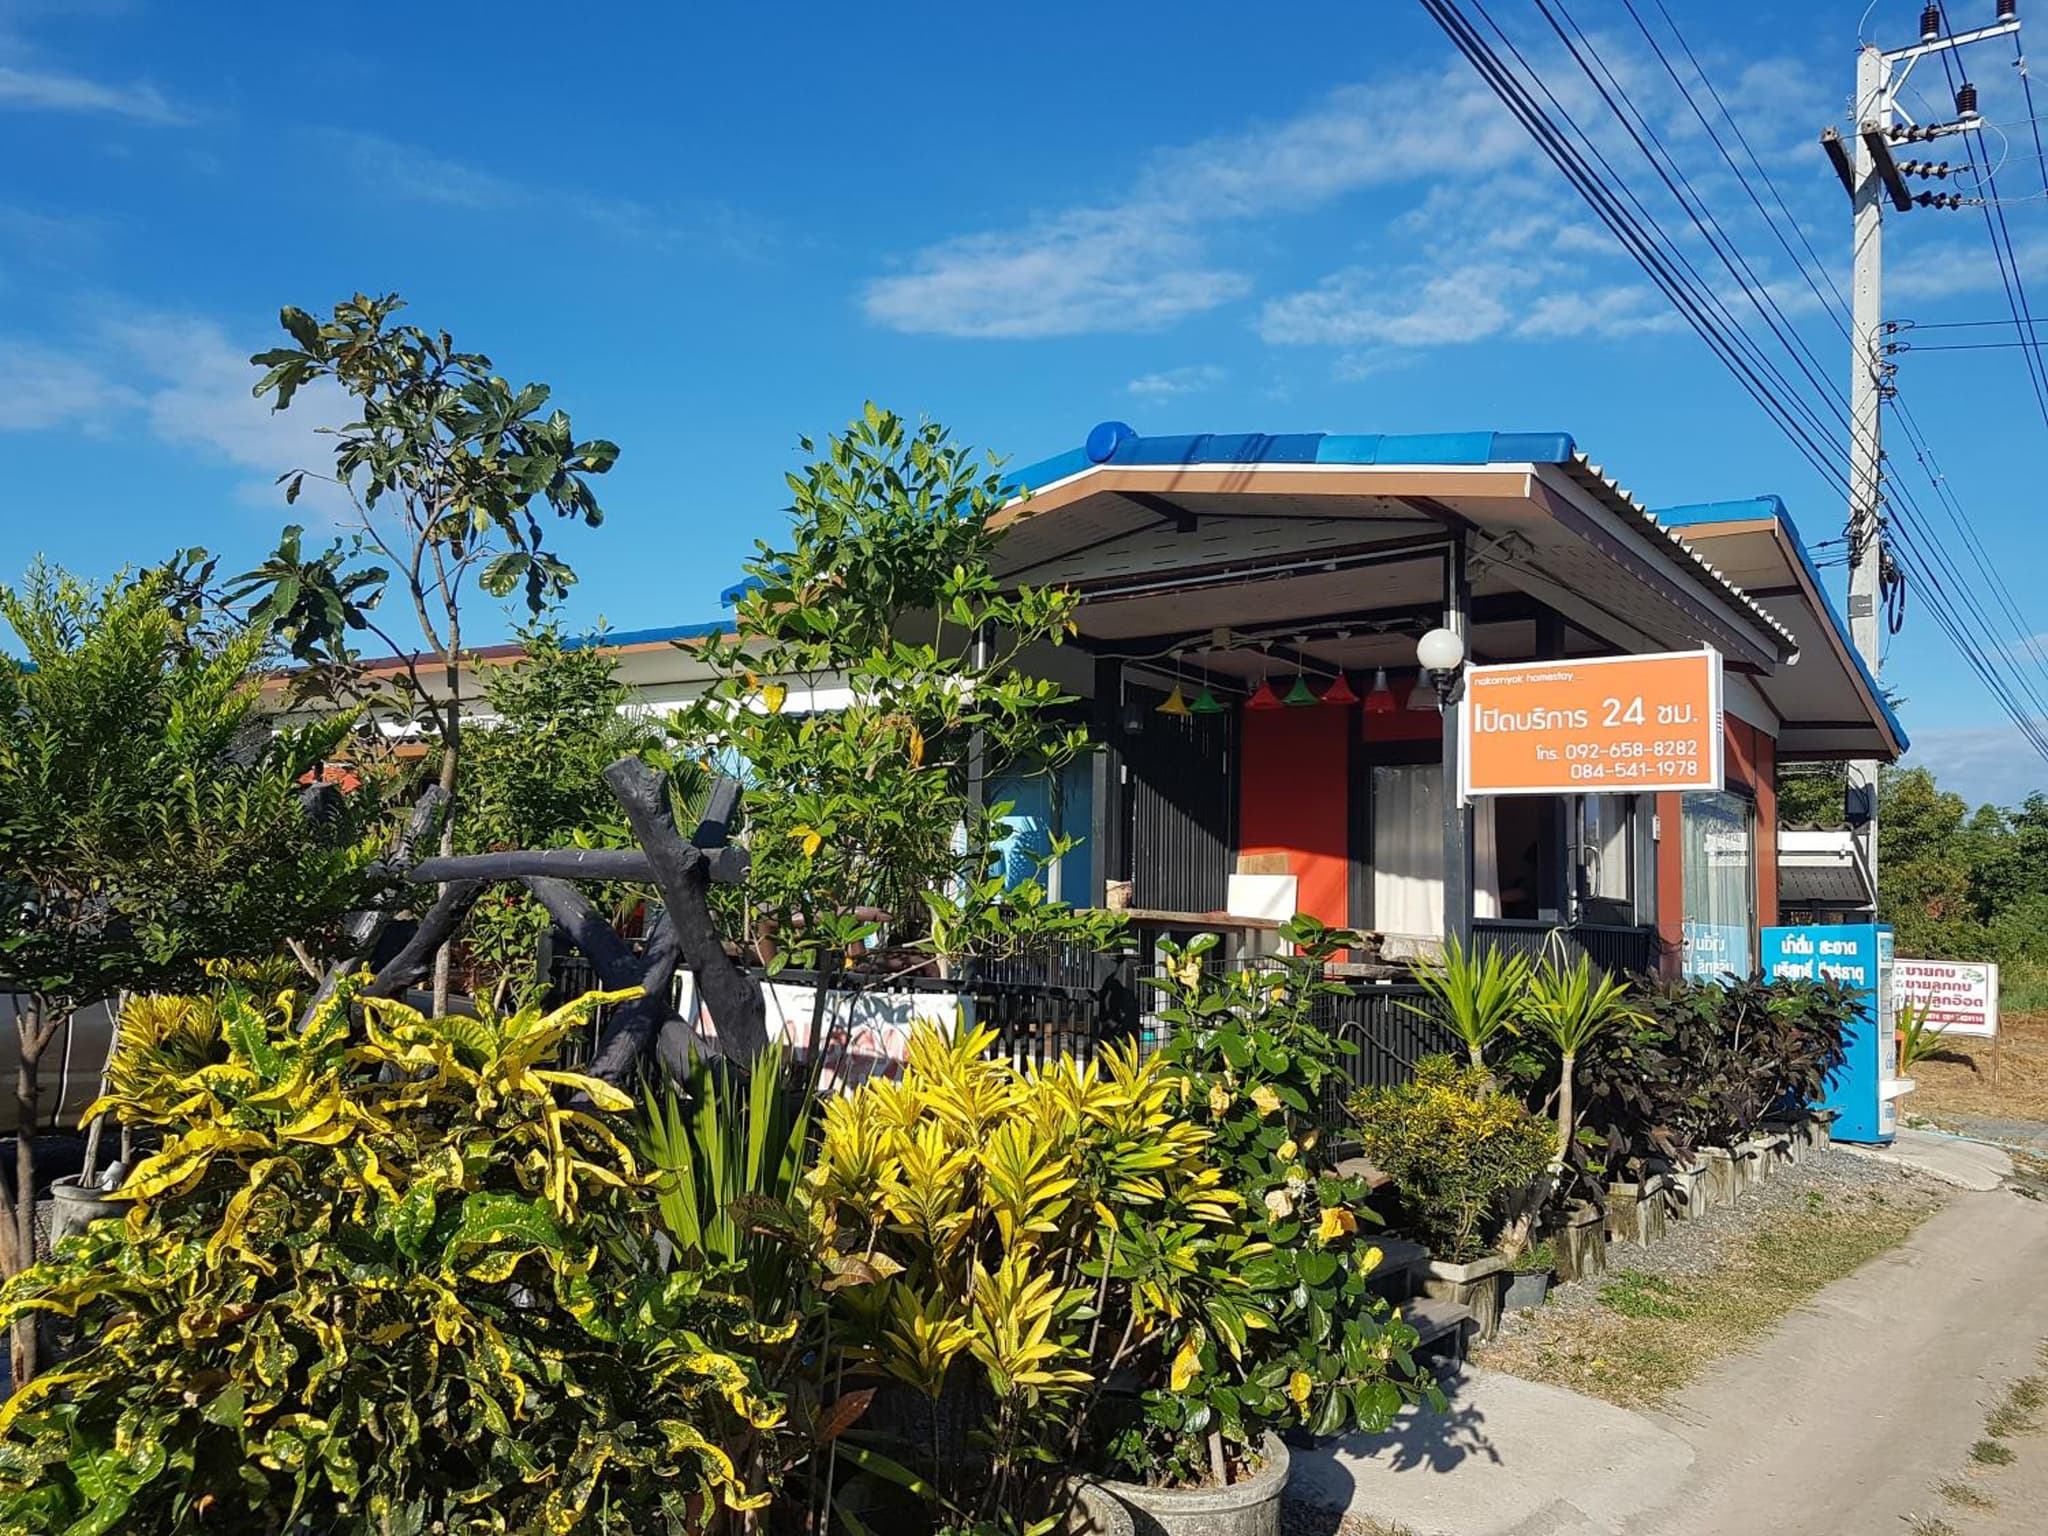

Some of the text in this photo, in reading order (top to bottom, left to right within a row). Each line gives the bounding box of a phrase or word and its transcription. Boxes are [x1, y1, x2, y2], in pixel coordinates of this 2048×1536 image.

[1474, 696, 1698, 733] เปิดบริการ 24 ชม.
[1536, 740, 1698, 761] โทร. 092-658-8282
[1570, 760, 1698, 779] 084-541-1978
[1819, 939, 1857, 956] สะอาด
[1905, 966, 1956, 978] ขายกบ
[1905, 979, 1973, 994] ขายลูกกบ
